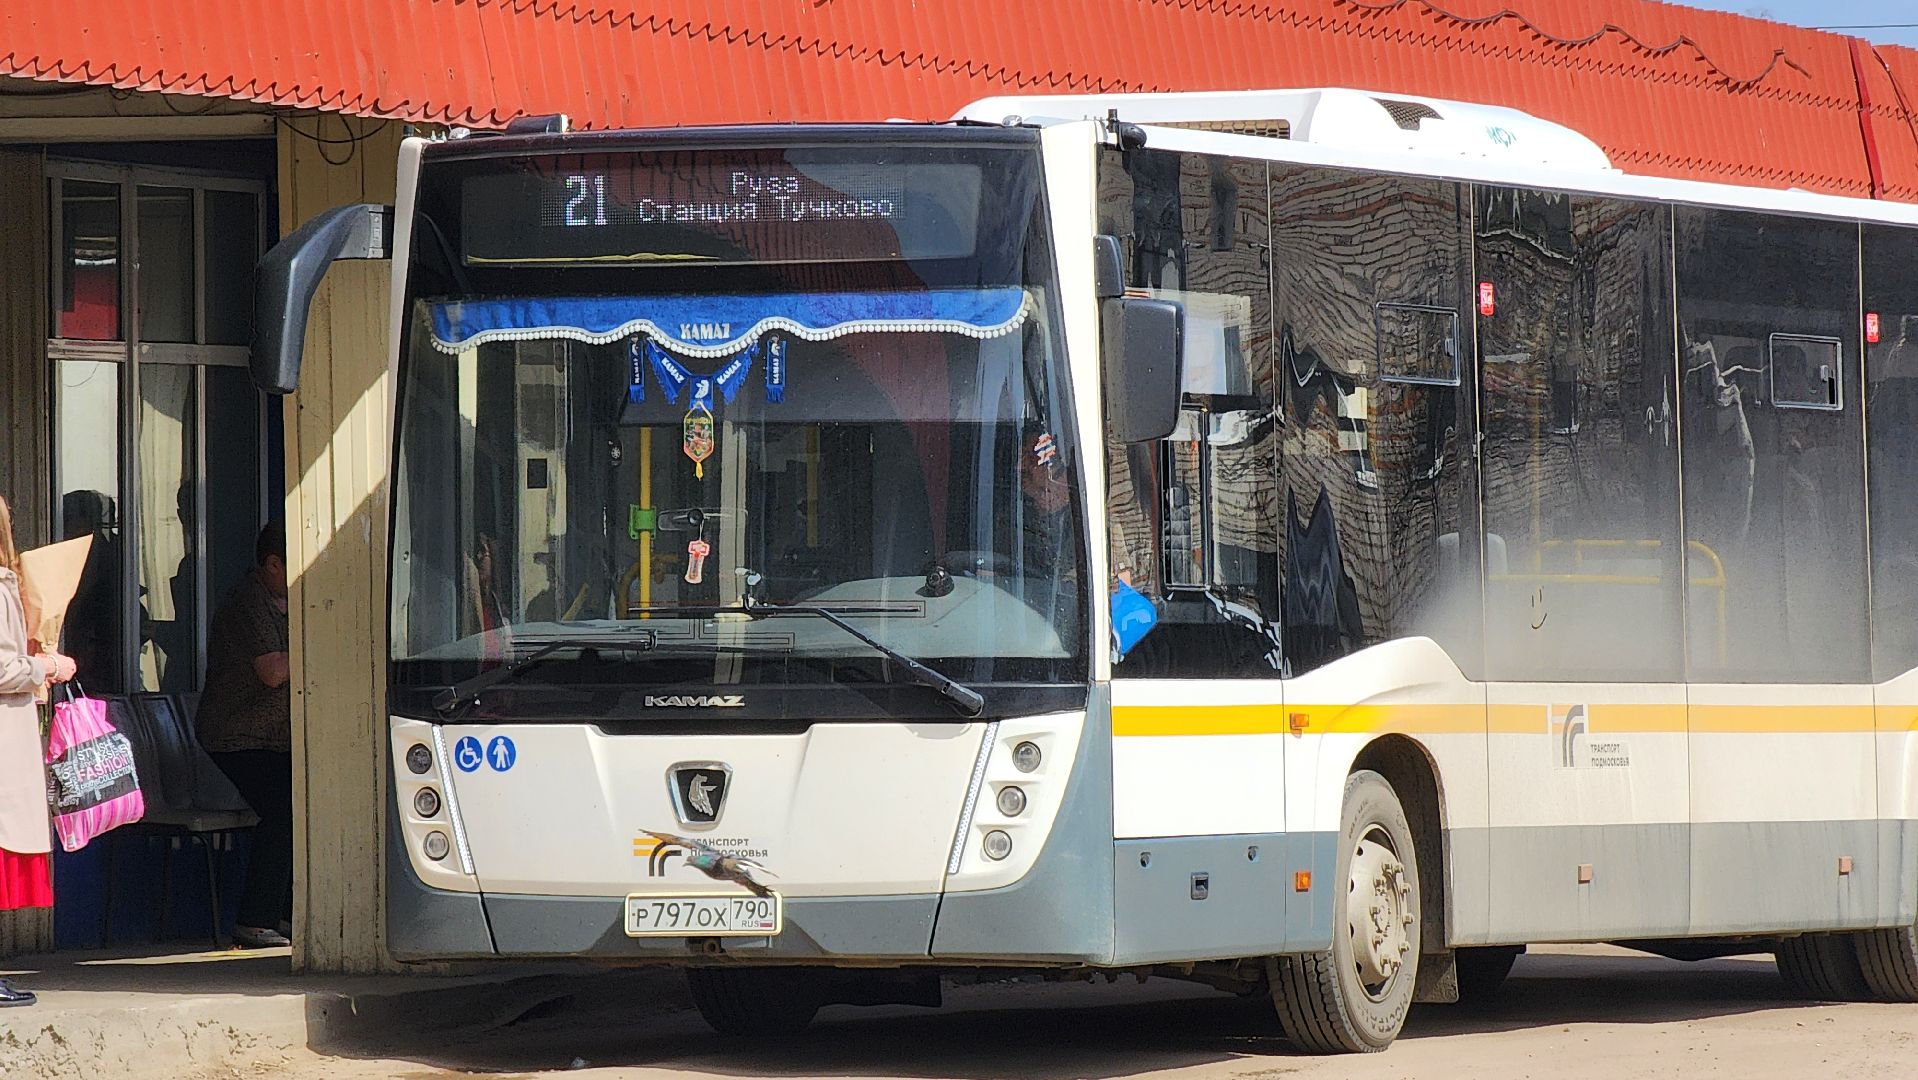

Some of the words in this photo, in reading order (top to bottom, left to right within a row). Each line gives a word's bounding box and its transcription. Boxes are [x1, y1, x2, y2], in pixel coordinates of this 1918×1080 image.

[731, 171, 800, 198] Руза
[565, 174, 609, 226] 21
[638, 198, 757, 224] Станция
[776, 196, 894, 221] Тучково
[680, 323, 730, 340] KAMAZ
[661, 357, 685, 384] KAMAZ
[716, 359, 742, 385] KAMAZ
[644, 695, 745, 707] KAMAZ
[1590, 743, 1620, 753] ТРАНСПОРТ
[77, 754, 129, 783] FASHION
[1591, 757, 1630, 768] ПОДМОСКОВЬЯ
[733, 899, 769, 919] 790
[741, 920, 759, 928] RUS
